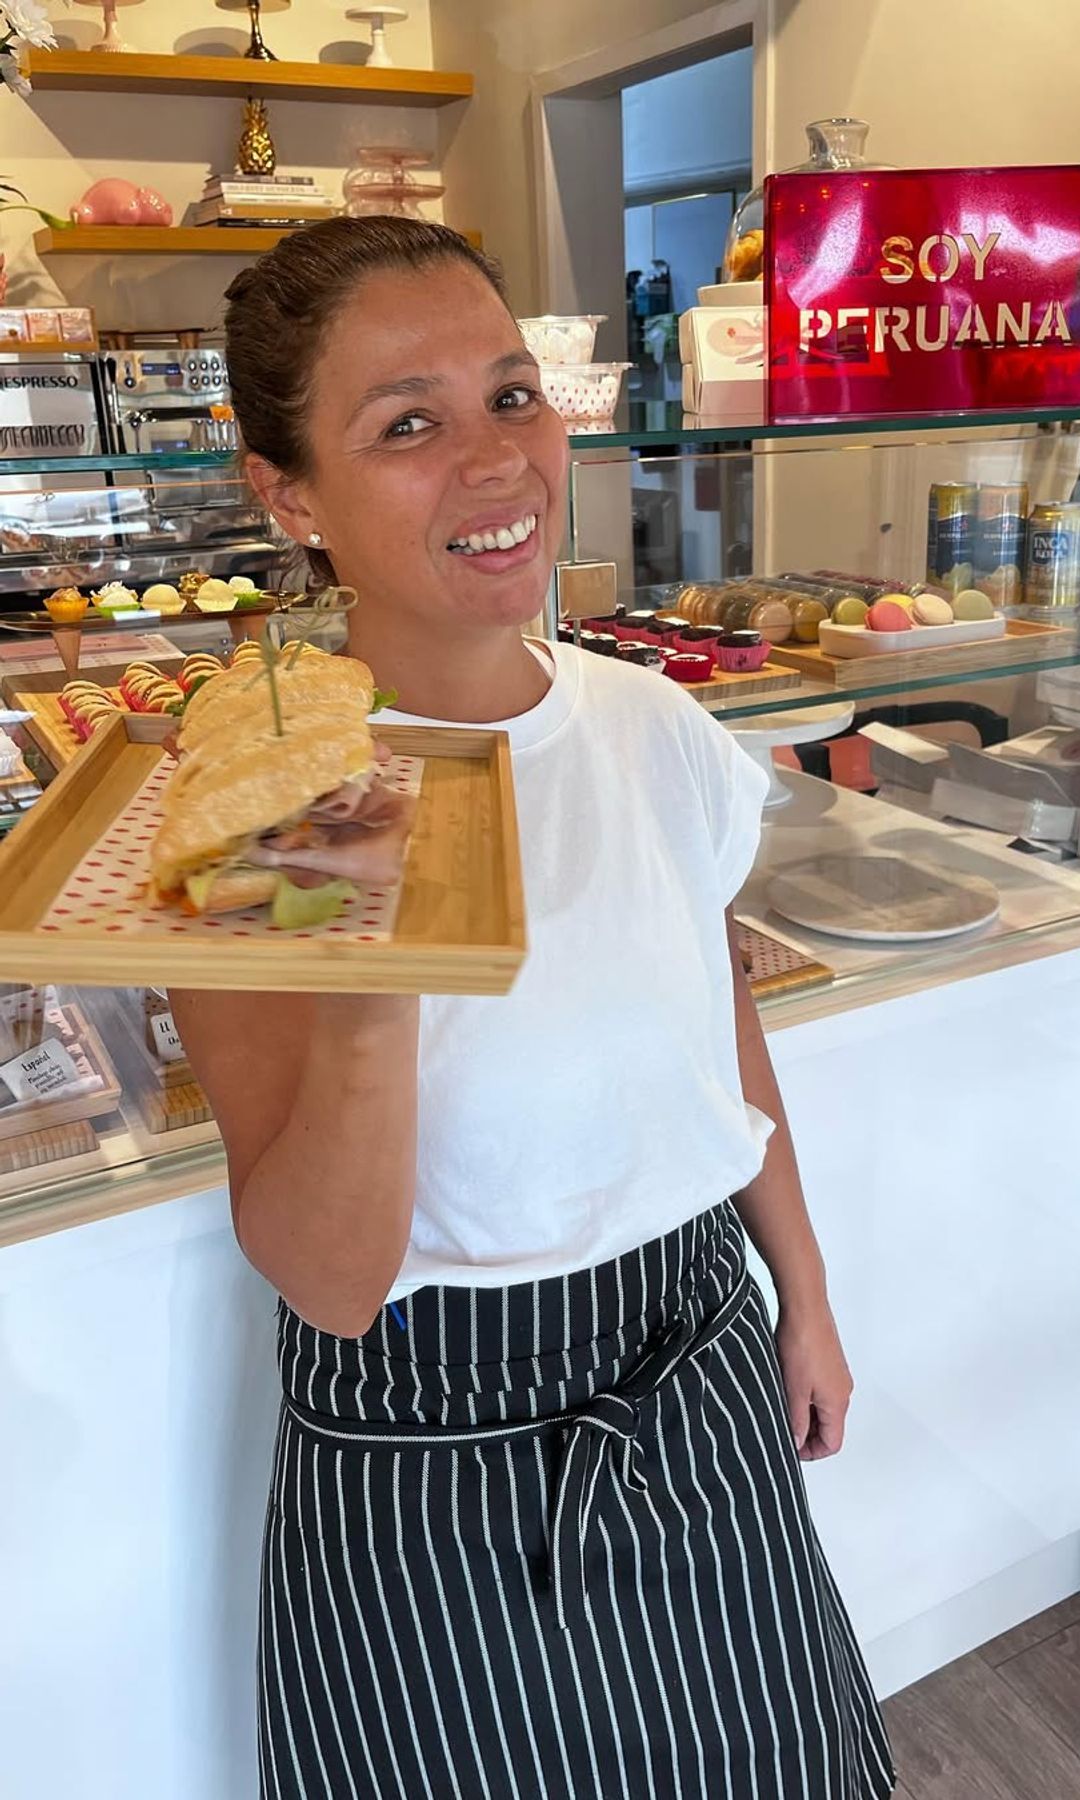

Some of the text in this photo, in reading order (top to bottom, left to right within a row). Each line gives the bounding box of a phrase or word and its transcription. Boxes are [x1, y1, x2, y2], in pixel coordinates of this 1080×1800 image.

[880, 232, 1002, 284] SOY
[799, 301, 1073, 354] PERUANA
[1033, 536, 1069, 550] INCA
